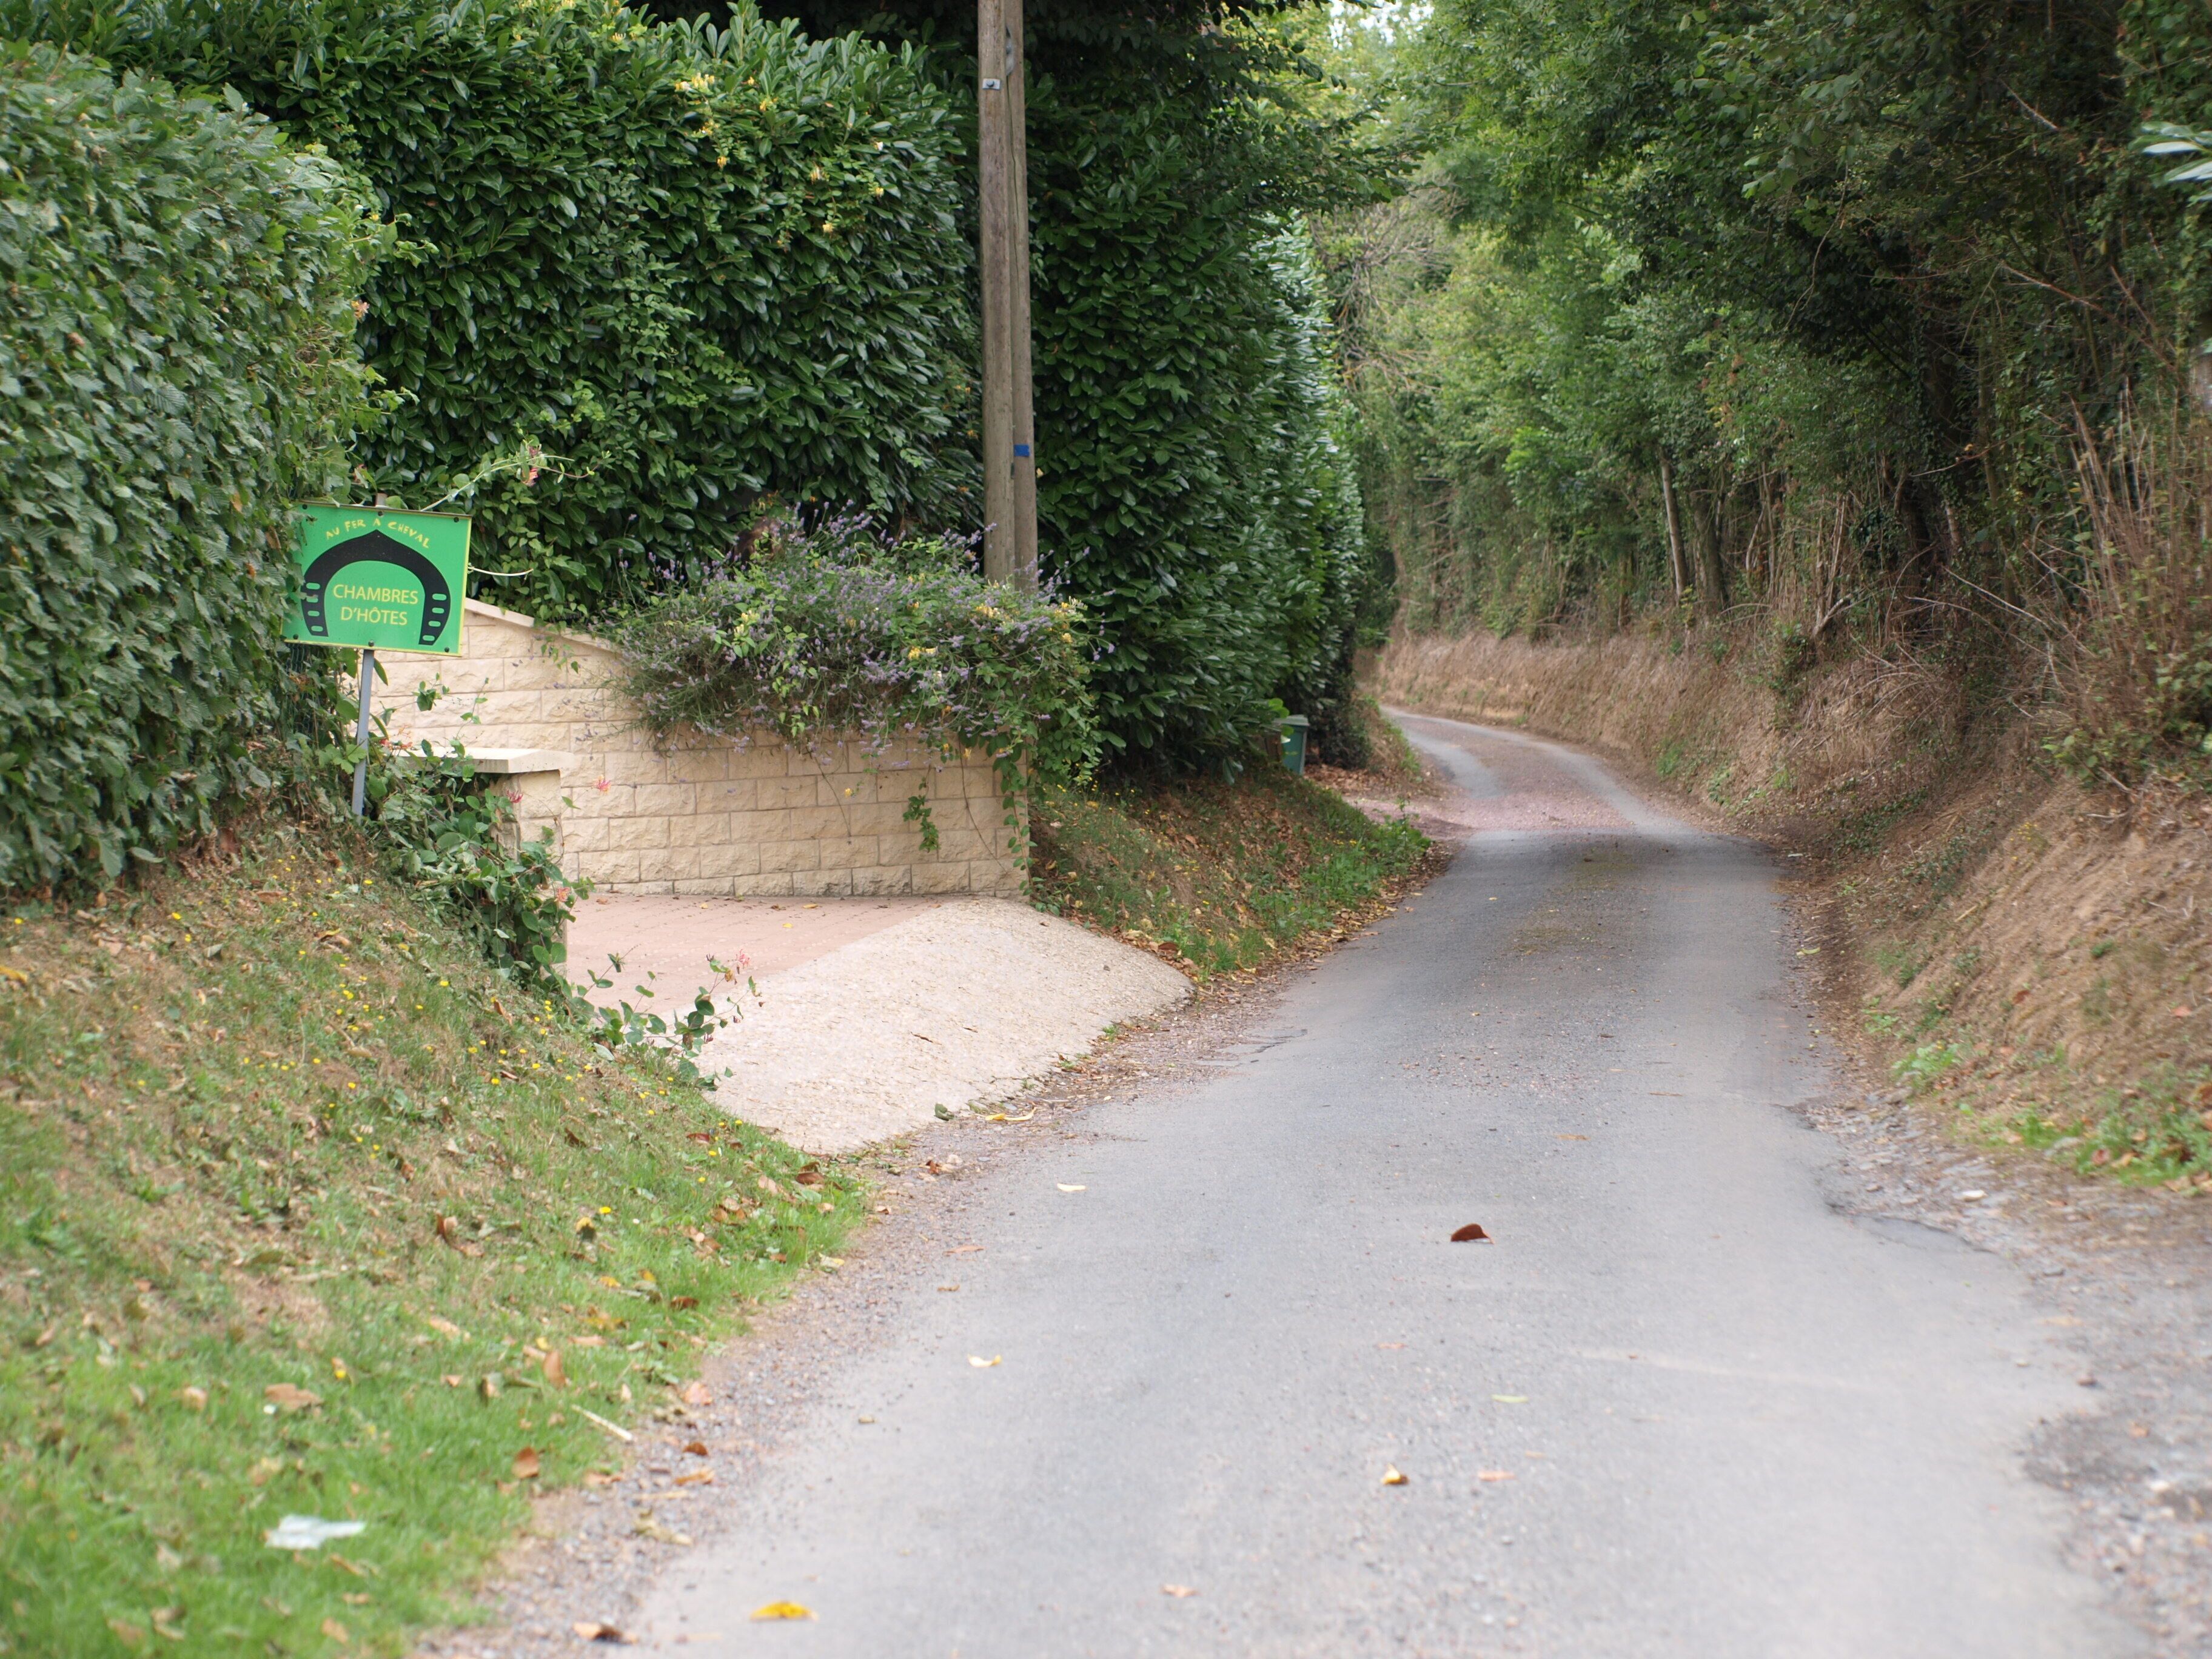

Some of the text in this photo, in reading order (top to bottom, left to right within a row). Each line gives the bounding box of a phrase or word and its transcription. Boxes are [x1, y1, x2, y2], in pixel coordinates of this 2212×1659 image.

[326, 527, 340, 540] AU
[344, 519, 366, 531] FER
[388, 521, 429, 548] CHEVAL
[333, 585, 418, 605] CHAMBRES
[341, 607, 407, 625] D'HÔTES
